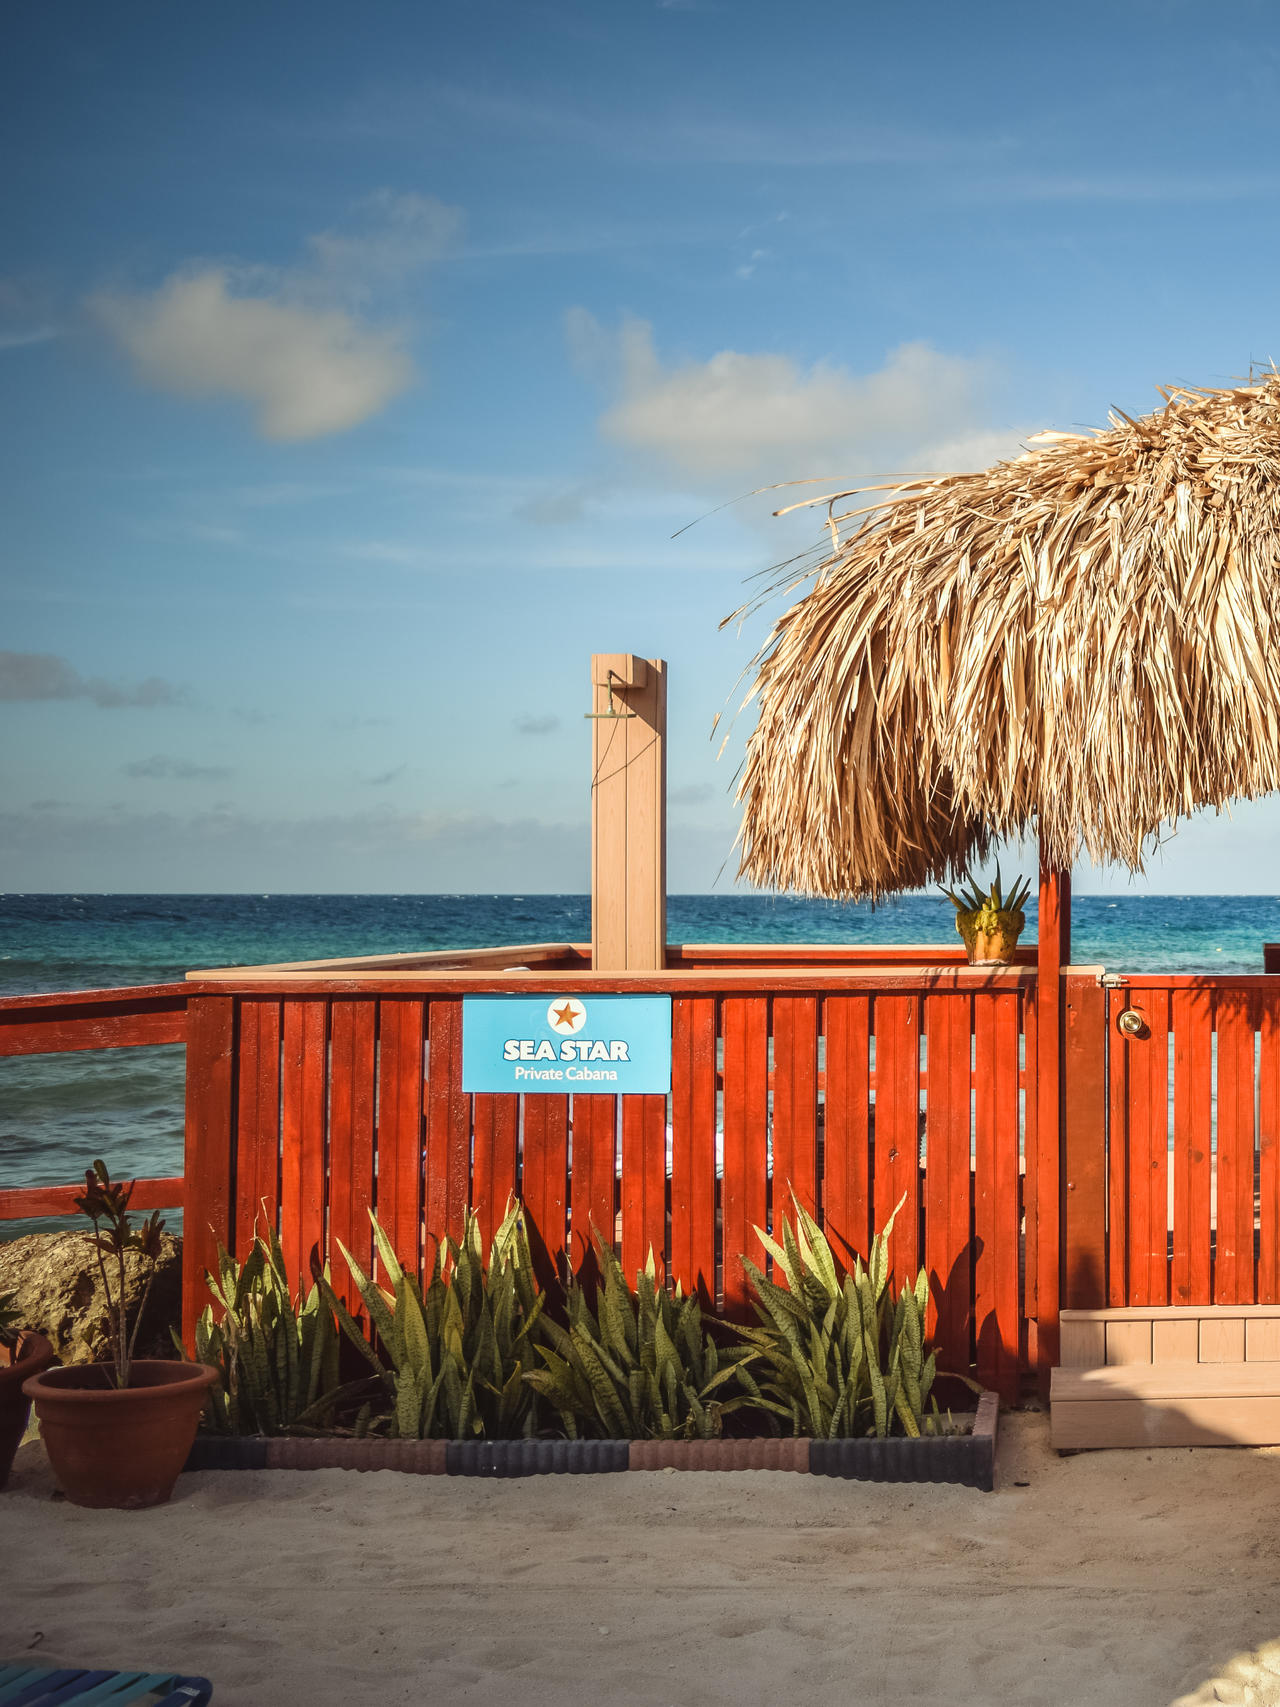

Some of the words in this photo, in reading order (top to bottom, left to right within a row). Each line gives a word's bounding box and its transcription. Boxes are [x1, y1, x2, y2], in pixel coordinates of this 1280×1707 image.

[503, 1039, 558, 1062] SEA
[559, 1039, 631, 1062] STAR
[515, 1066, 563, 1080] Private
[565, 1066, 617, 1080] Cabana
